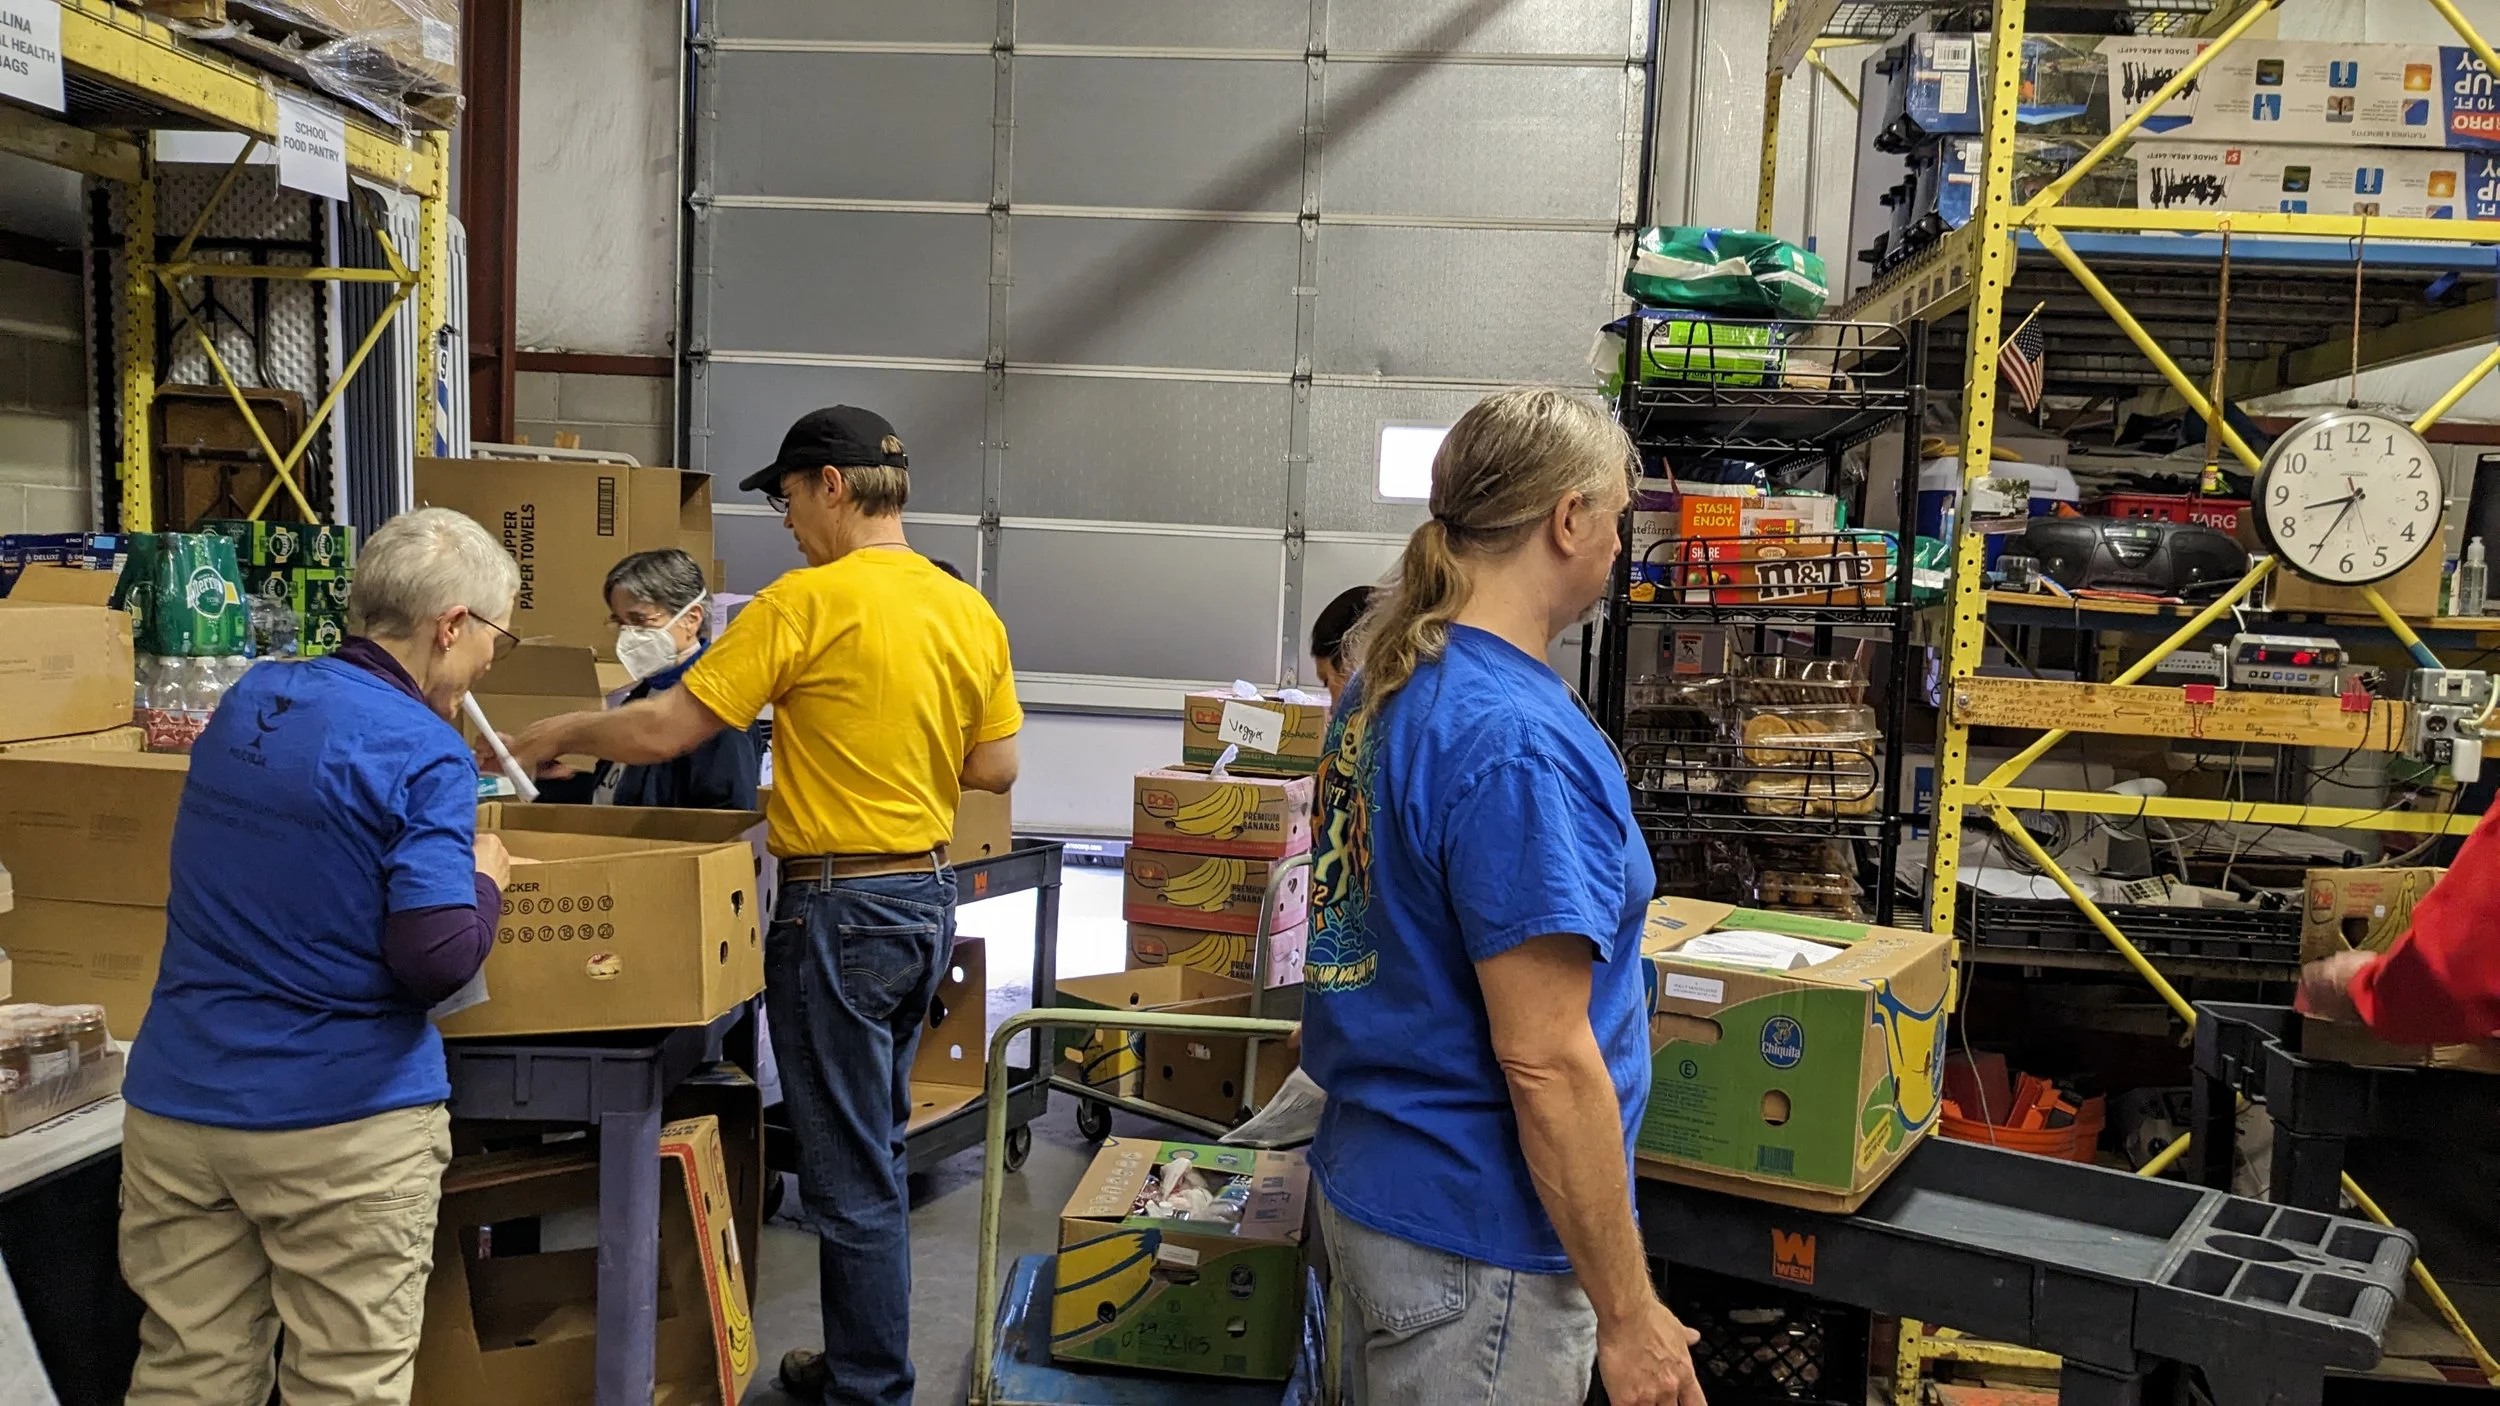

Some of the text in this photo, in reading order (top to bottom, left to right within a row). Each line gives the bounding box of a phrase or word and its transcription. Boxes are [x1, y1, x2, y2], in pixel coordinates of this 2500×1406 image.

[0, 10, 32, 35] LINA
[11, 37, 55, 63] HEALTH
[2164, 47, 2190, 55] SHADE
[2453, 96, 2476, 109] FT.
[295, 121, 329, 142] SCHOOL
[283, 136, 339, 162] FOOD PANTRY
[2313, 430, 2333, 451] 11
[2345, 422, 2371, 444] 12
[2385, 434, 2395, 456] 1
[2283, 453, 2307, 474] 10
[2407, 457, 2423, 479] 2
[2273, 485, 2289, 507] 9
[2415, 490, 2429, 512] 3
[1695, 503, 1736, 515] STASH.
[1693, 515, 1736, 527] ENJOY.
[2280, 516, 2296, 538] 8
[2400, 521, 2415, 542] 4
[520, 503, 535, 610] PAPER TOWELS
[2339, 552, 2355, 574] 6
[2373, 546, 2389, 567] 5
[1147, 793, 1175, 806] Dole
[1242, 811, 1281, 823] PREMIUM
[1243, 821, 1281, 832] BANANAS
[1761, 1041, 1801, 1060] Chiquita
[1775, 1264, 1812, 1279] WEN
